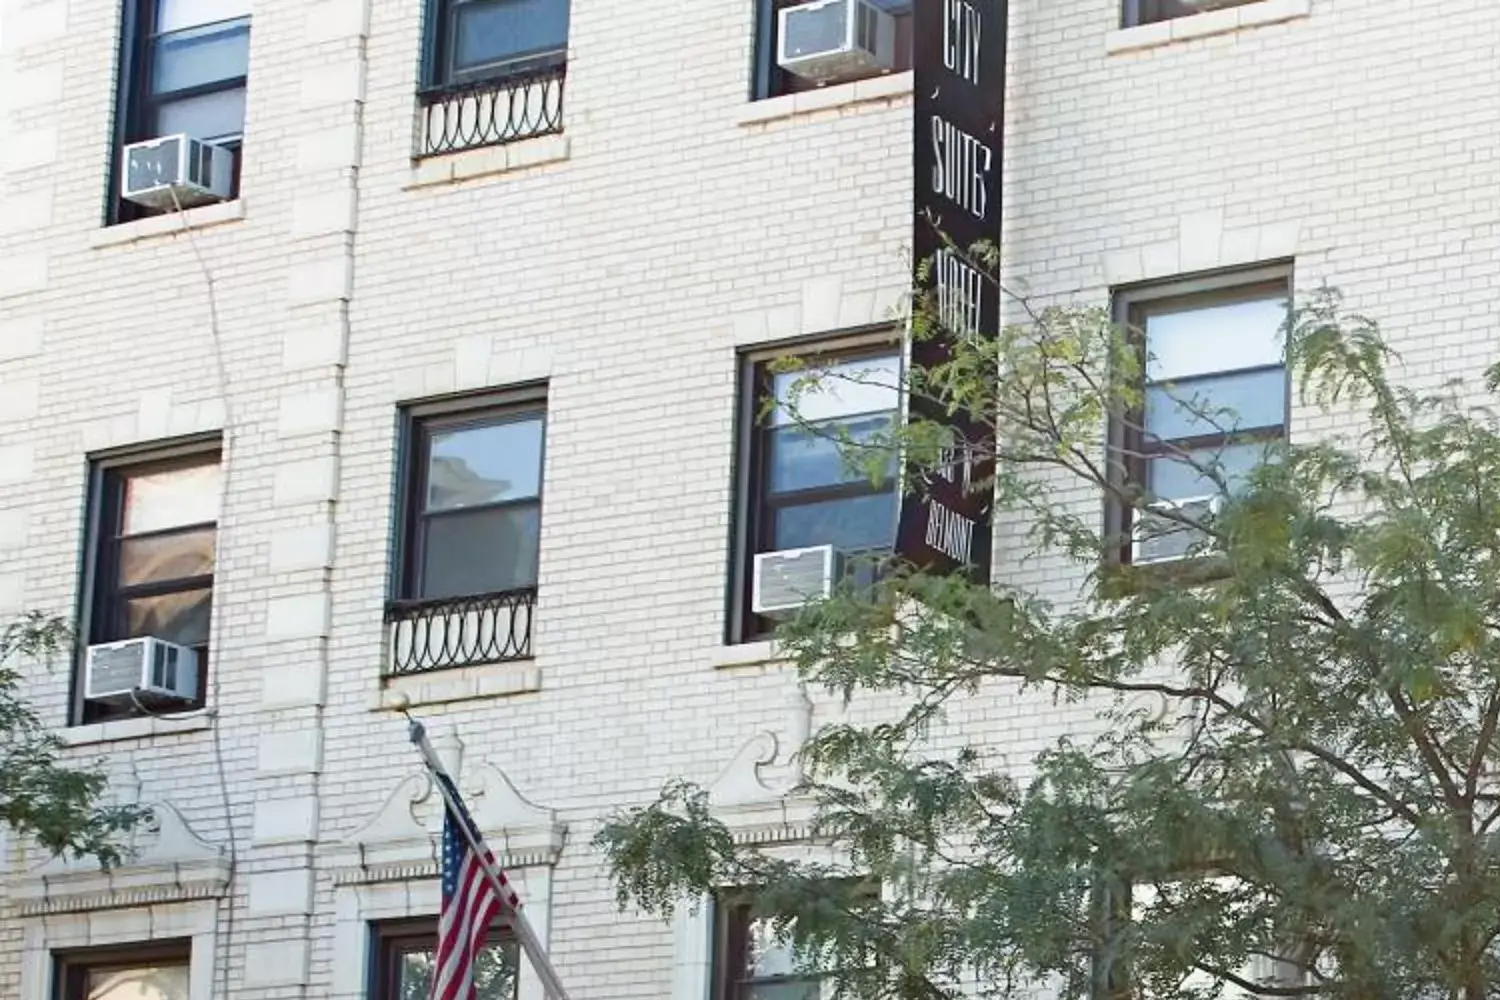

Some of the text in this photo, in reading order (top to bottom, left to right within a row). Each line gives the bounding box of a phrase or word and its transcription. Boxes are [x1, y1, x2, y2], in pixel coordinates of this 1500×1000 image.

[944, 0, 981, 85] CITY
[932, 115, 992, 220] SUITES
[925, 498, 977, 566] BELMONT
